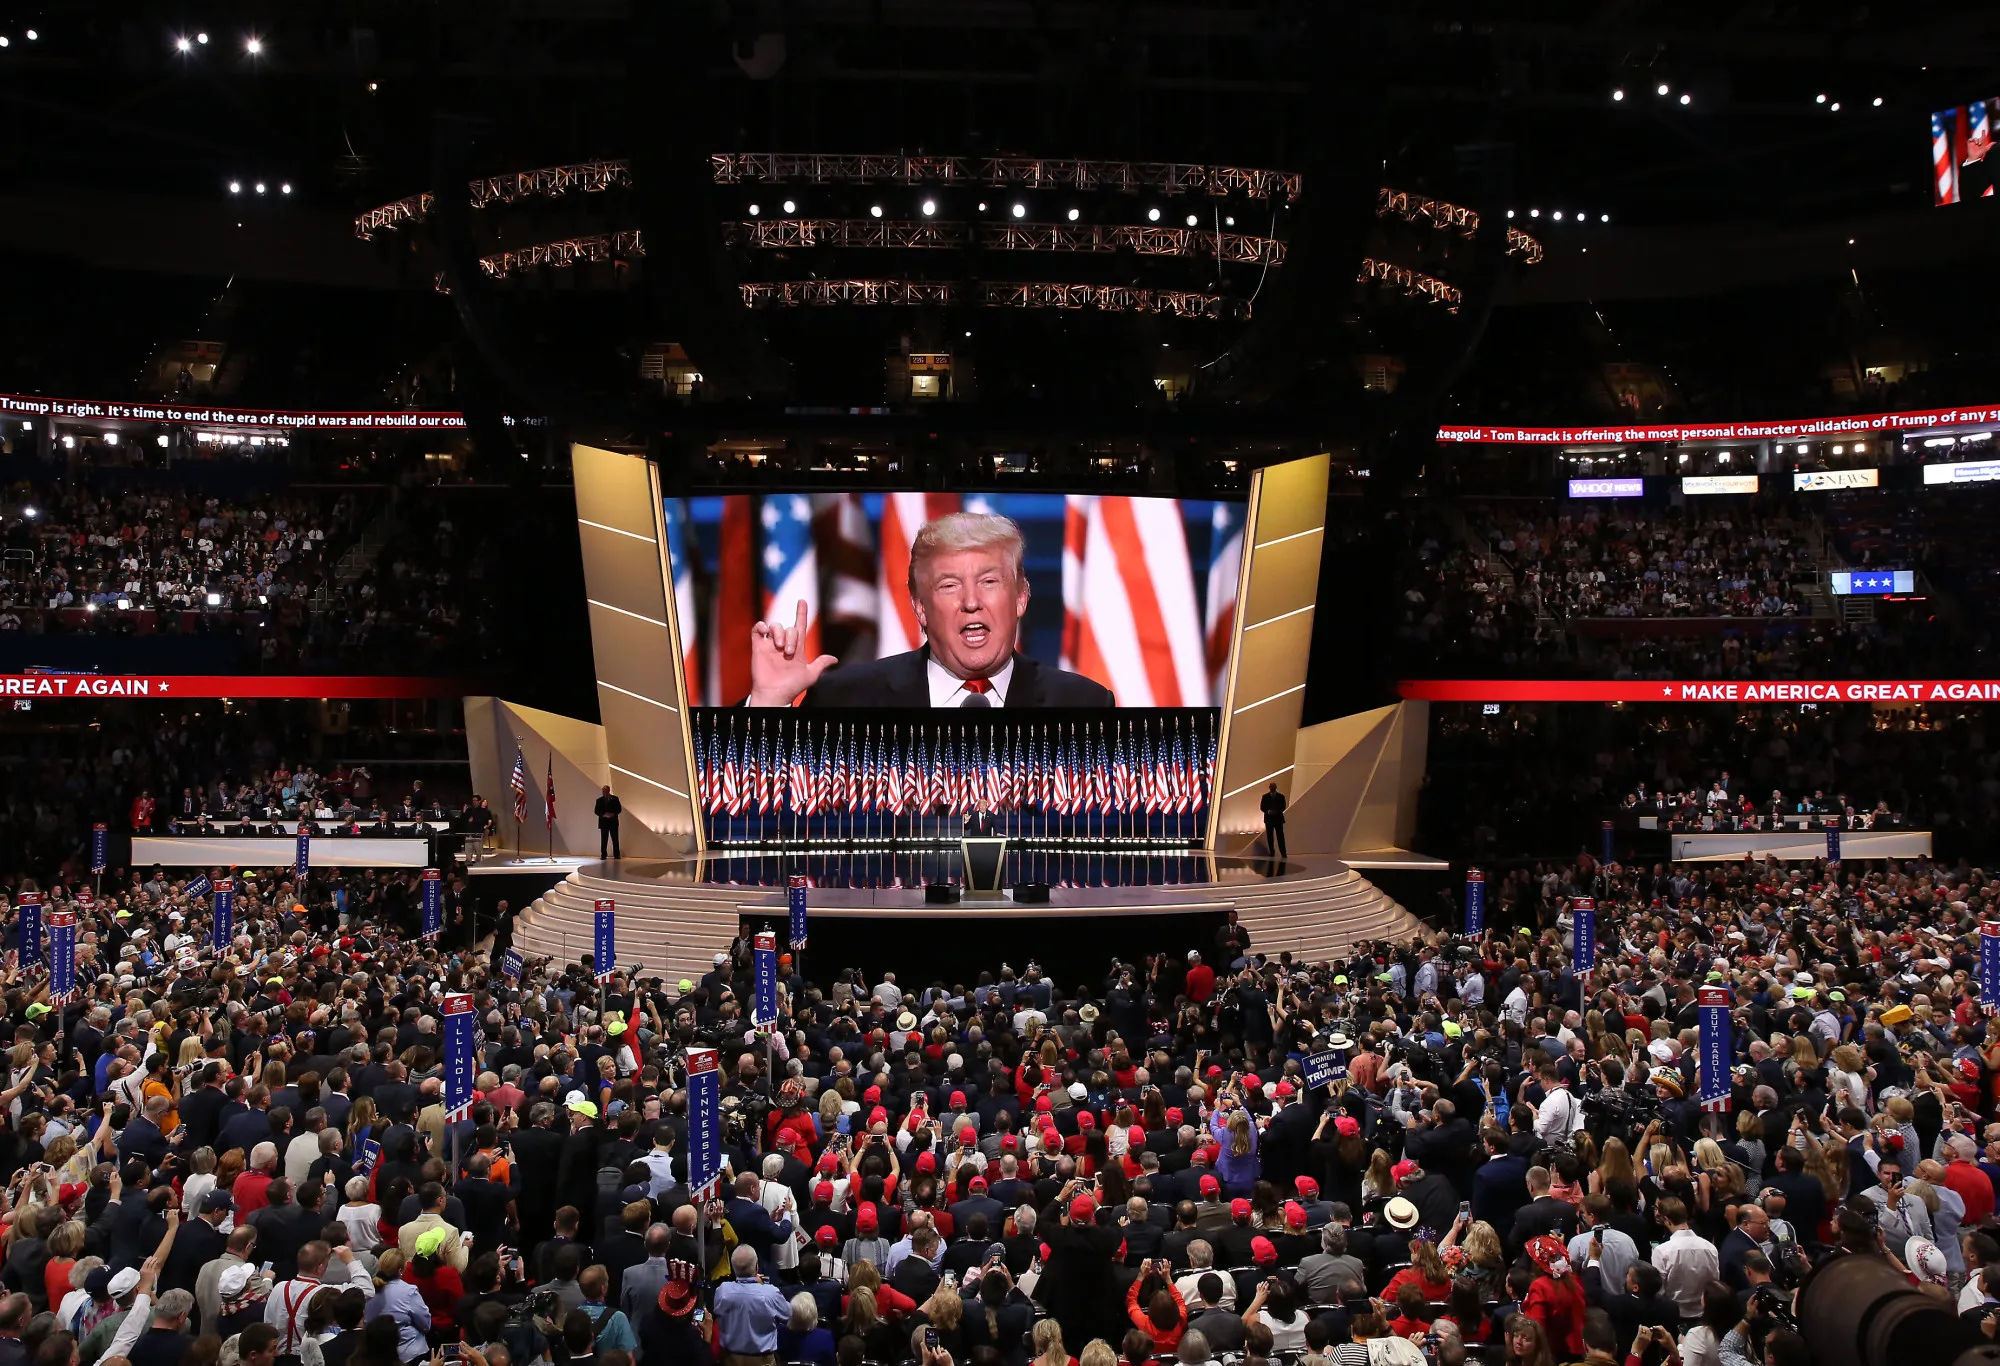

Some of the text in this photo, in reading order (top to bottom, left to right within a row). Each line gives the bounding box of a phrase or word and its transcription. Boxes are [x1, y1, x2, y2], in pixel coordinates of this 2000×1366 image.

[1, 398, 49, 414] Trump
[53, 402, 63, 412] is
[67, 403, 104, 417] right.
[109, 406, 129, 416] It's
[133, 407, 164, 418] time
[167, 410, 181, 419] to
[185, 411, 209, 421] end
[212, 411, 234, 422] the
[237, 415, 257, 423] era
[261, 414, 274, 424] of
[277, 415, 315, 427] stupid
[350, 415, 371, 425] and
[375, 415, 416, 425] rebuild
[1436, 429, 1480, 441] teagold
[1490, 430, 1514, 440] Tom
[1518, 431, 1560, 441] Barrack
[1563, 431, 1572, 441] is
[1575, 430, 1622, 442] offering
[1625, 429, 1645, 439] the
[1648, 429, 1678, 438] most
[1682, 426, 1734, 441] personal
[1737, 425, 1797, 437] character
[1800, 418, 1869, 433] validation
[1872, 417, 1887, 427] of
[1890, 415, 1937, 426] Trump
[1941, 411, 1956, 422] of
[1960, 411, 1986, 422] any
[1571, 483, 1613, 493] YAHOO!
[1827, 473, 1869, 485] NEWS
[75, 680, 148, 694] AGAIN
[1683, 685, 1737, 699] MAKE
[1744, 685, 1840, 699] AMERICA
[1847, 685, 1923, 699] GREAT
[1711, 1008, 1719, 1037] SOUTH
[455, 1018, 463, 1095] ILLINOIS
[1309, 1053, 1336, 1066] WOMEN
[1711, 1042, 1720, 1089] CAROLINA
[1307, 1065, 1346, 1084] TRUMP
[1317, 1062, 1329, 1071] FOR
[701, 1076, 710, 1171] TENNESSEE
